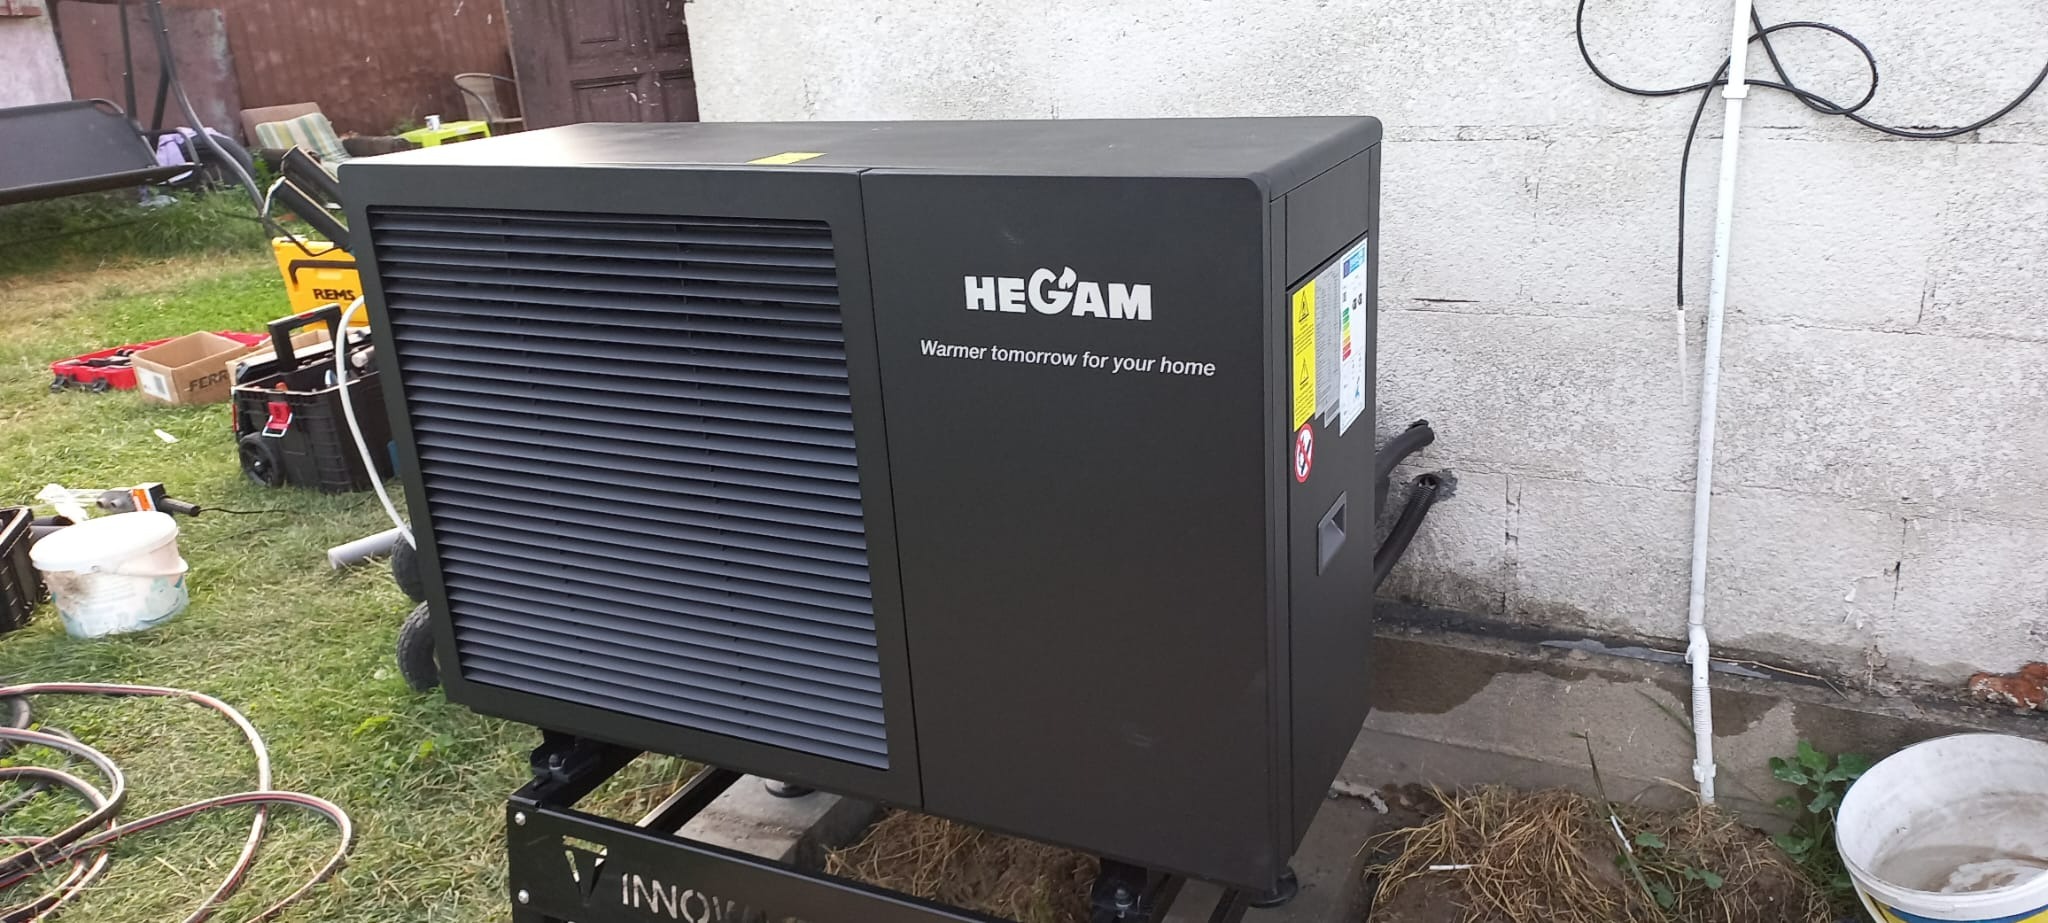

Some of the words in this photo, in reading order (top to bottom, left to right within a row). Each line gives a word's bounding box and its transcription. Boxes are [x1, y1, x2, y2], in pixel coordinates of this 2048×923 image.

[312, 288, 356, 301] REMS
[963, 266, 1153, 321] HEGAM
[920, 339, 987, 360] Warmer
[991, 344, 1077, 367] tomorrow
[1082, 351, 1108, 369] for
[1111, 355, 1156, 374] your
[1160, 356, 1217, 377] home
[188, 369, 230, 392] FERR
